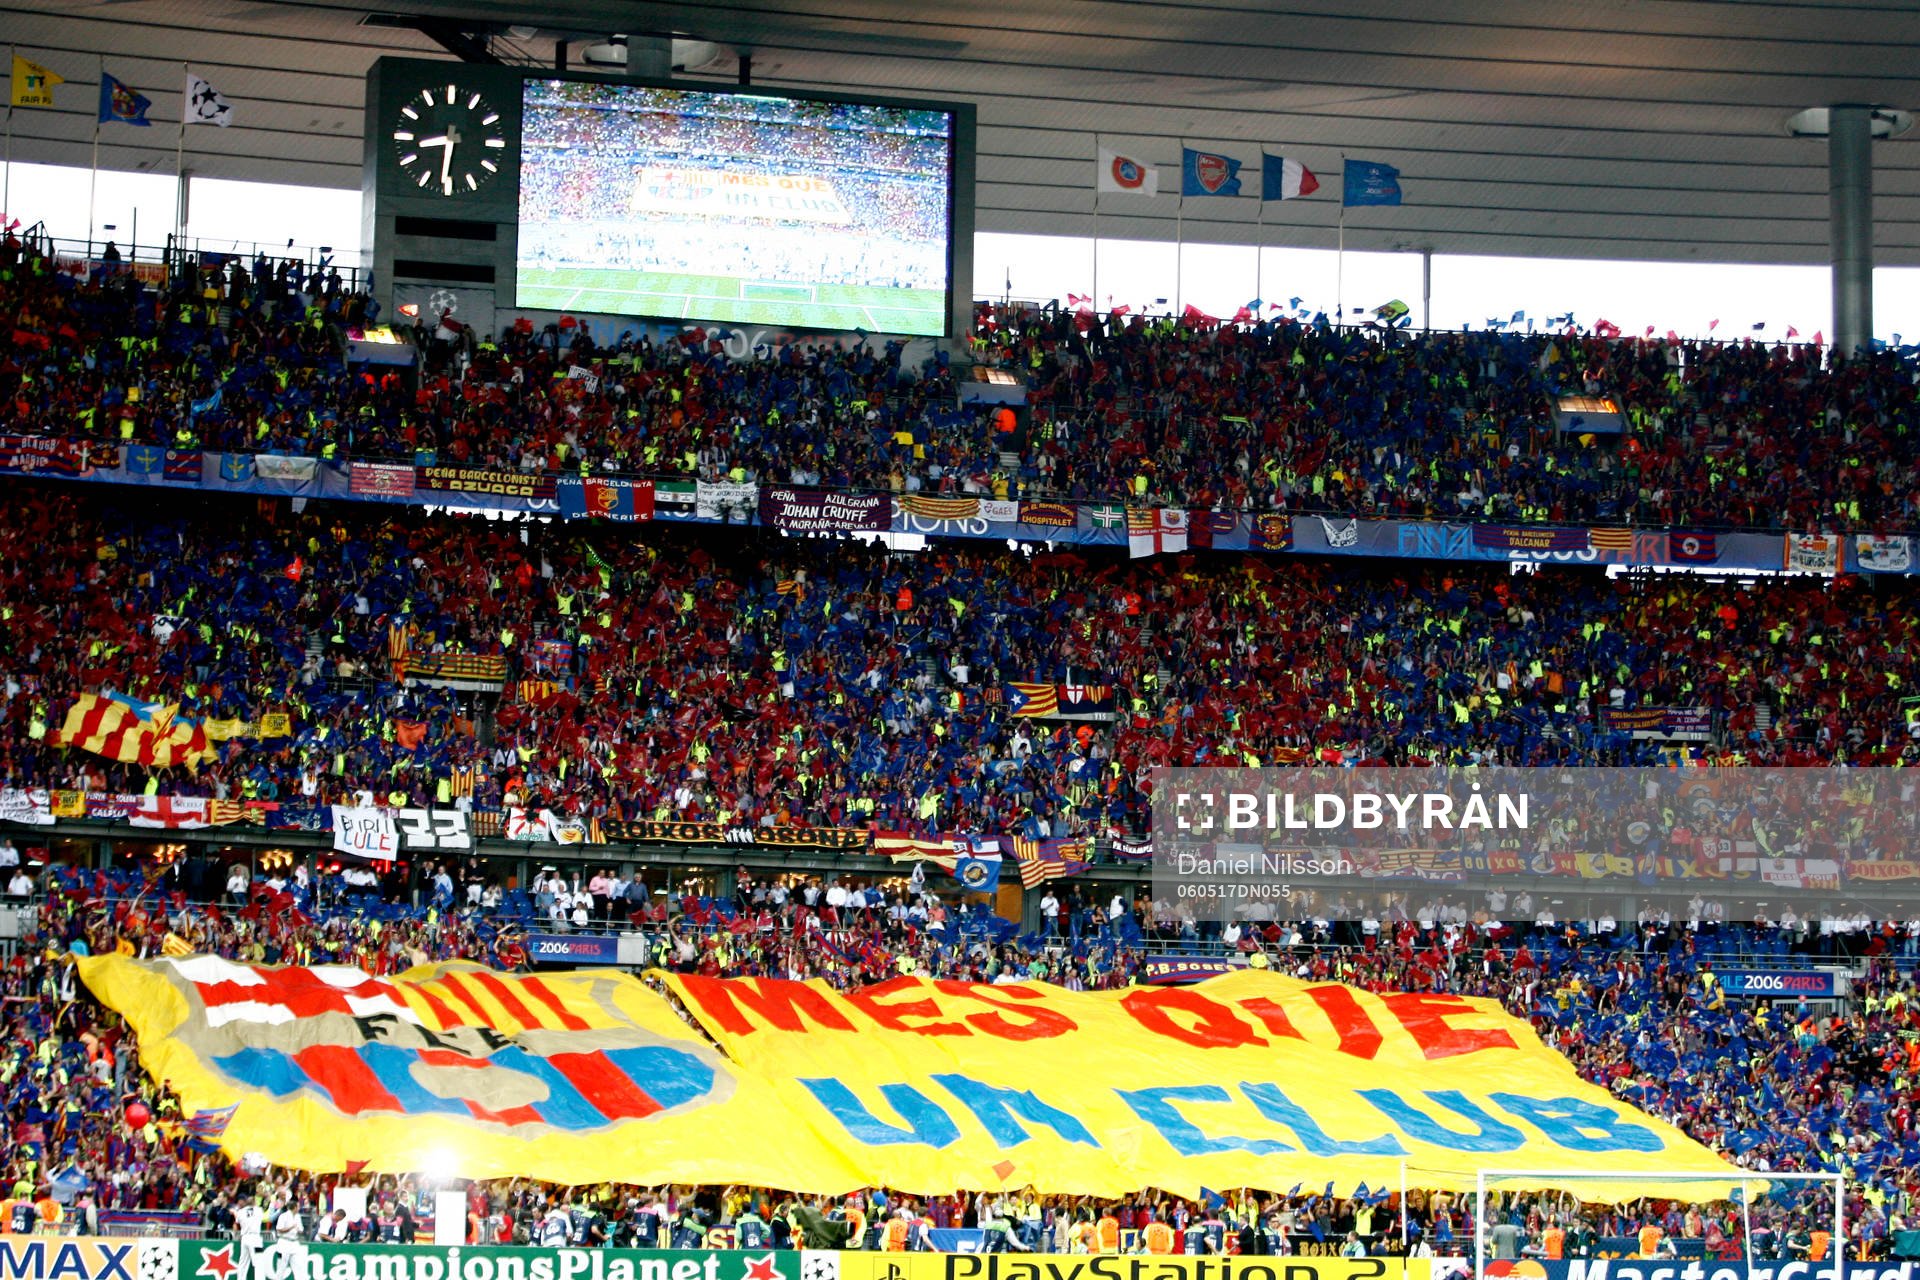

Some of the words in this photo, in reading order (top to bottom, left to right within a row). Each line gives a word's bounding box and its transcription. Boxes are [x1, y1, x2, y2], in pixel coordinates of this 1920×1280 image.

[450, 480, 534, 497] AZUAGA
[771, 490, 796, 502] PEÑA
[825, 494, 879, 507] AZULGRANA
[590, 510, 648, 521] TENERIFE
[780, 504, 819, 518] JOHAN
[822, 505, 867, 522] CRUYFF
[605, 820, 720, 841] BOIXOS
[755, 826, 861, 848] OSONA
[1464, 855, 1527, 870] BOIXOS
[540, 942, 569, 953] 2006
[569, 943, 602, 955] PARIS
[1744, 975, 1783, 990] 2006
[1783, 976, 1826, 991] PARIS
[680, 974, 1079, 1041] MES
[1120, 985, 1518, 1060] QUE
[795, 1074, 1102, 1149] UN
[1113, 1081, 1666, 1156] CLUB
[945, 1253, 1318, 1280] PlayStation
